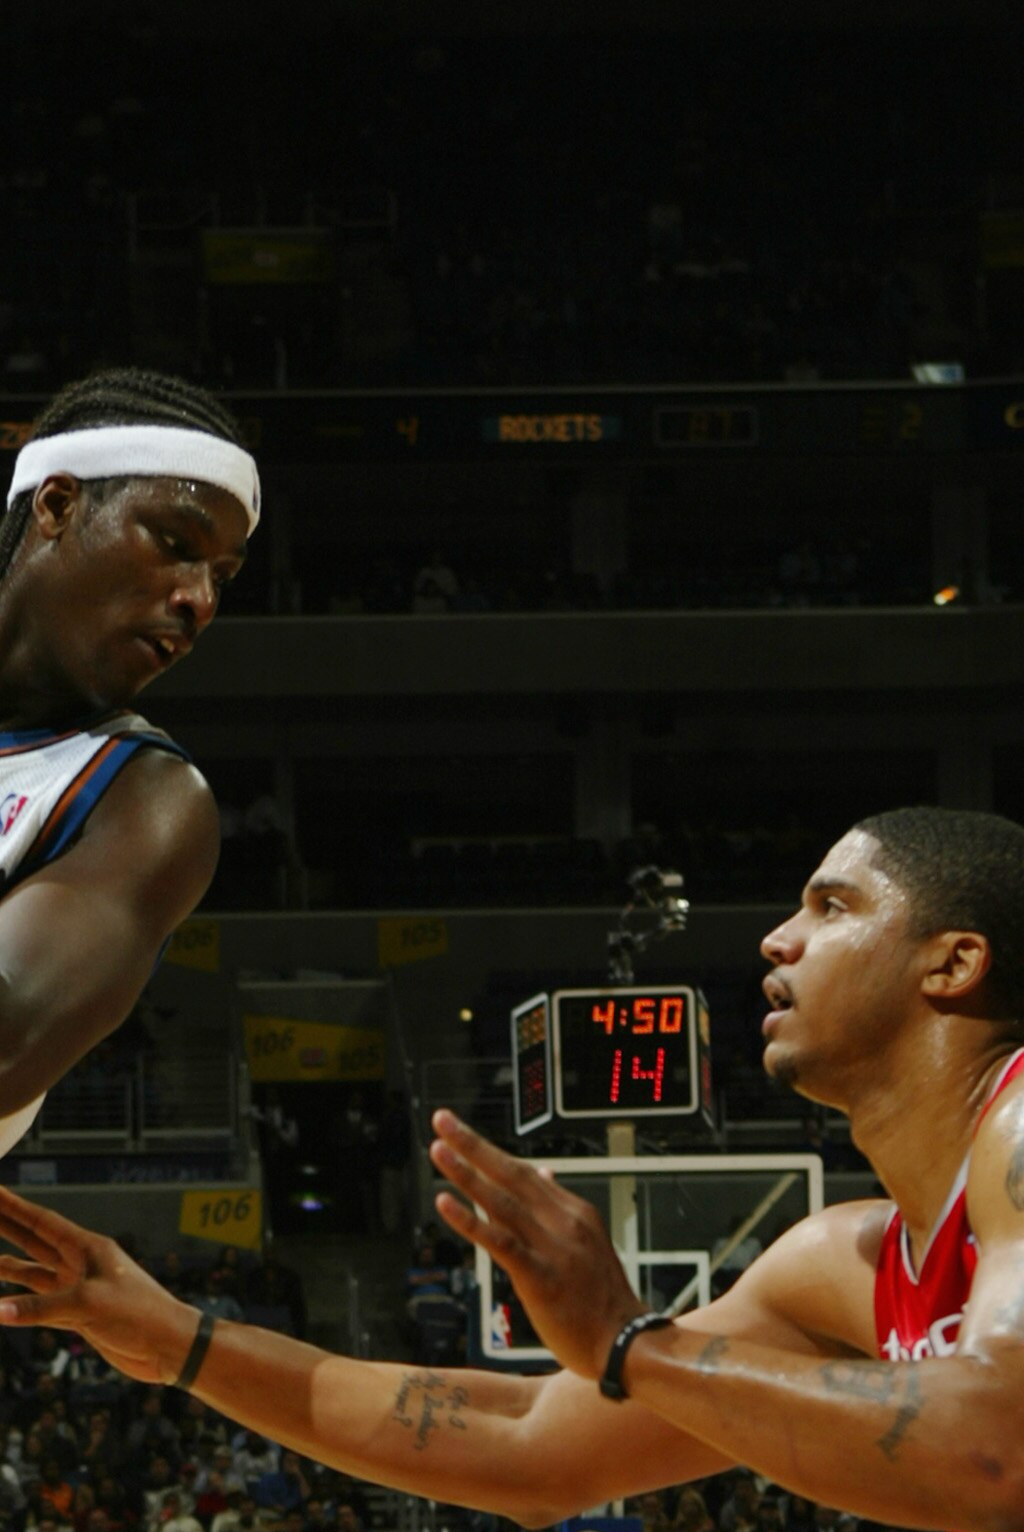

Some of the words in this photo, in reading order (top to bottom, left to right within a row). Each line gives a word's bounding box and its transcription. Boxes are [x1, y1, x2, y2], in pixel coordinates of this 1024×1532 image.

[498, 412, 604, 442] ROCKETS
[592, 998, 684, 1035] 4:50
[610, 1047, 665, 1104] 14
[198, 1194, 252, 1229] 106
